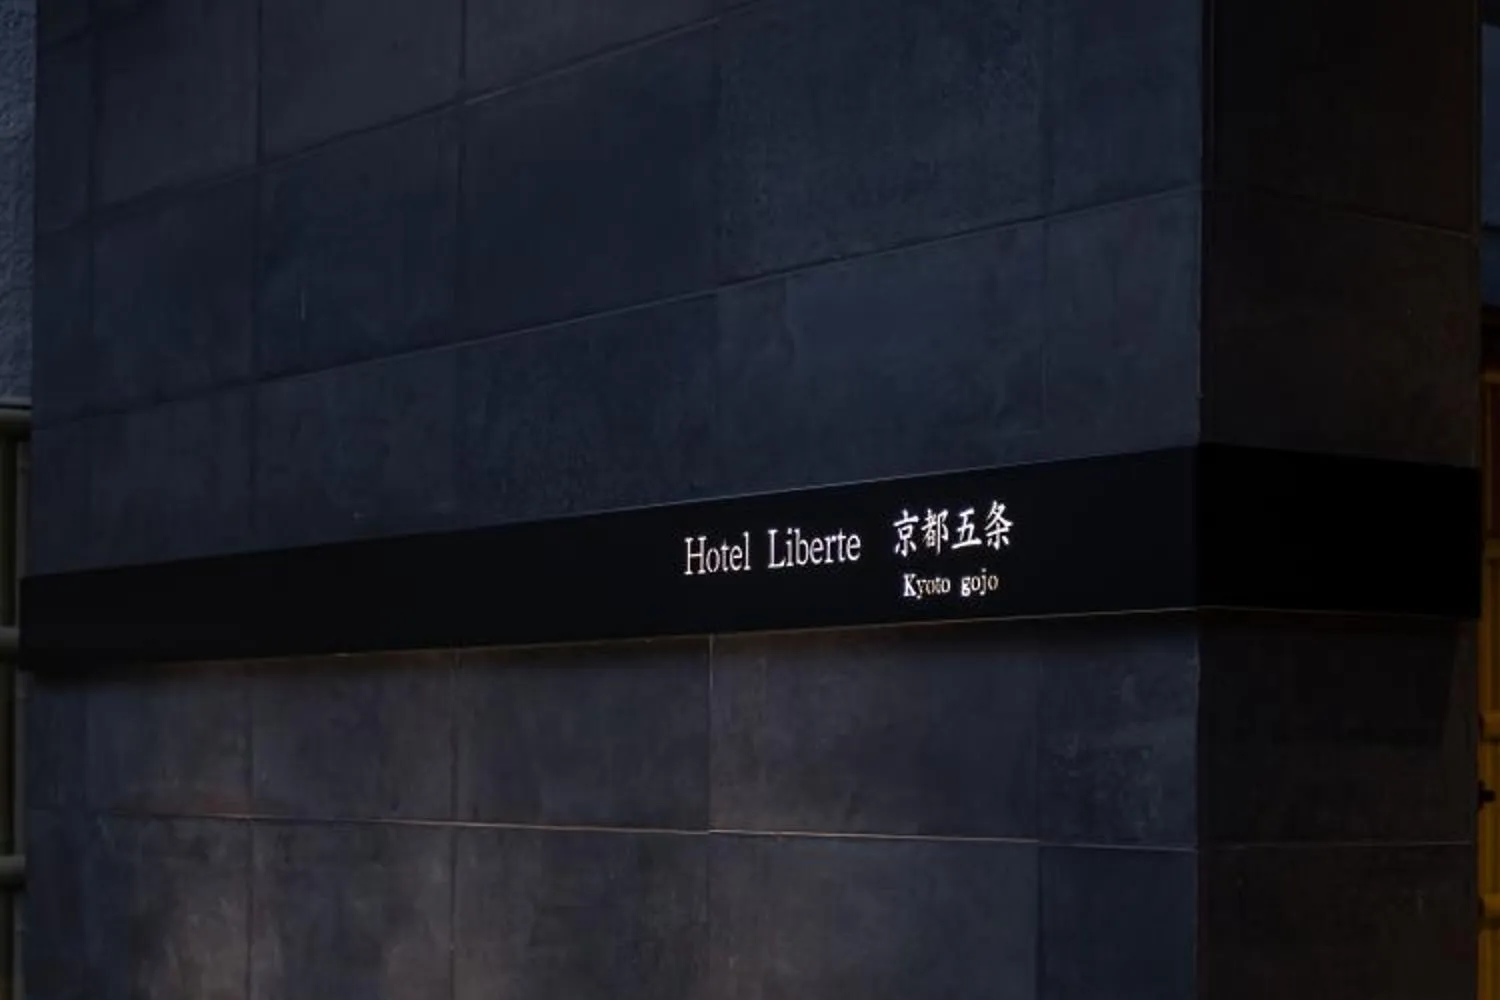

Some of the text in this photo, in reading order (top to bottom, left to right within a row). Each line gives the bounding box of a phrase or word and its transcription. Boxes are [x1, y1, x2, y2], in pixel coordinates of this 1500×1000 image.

[683, 499, 1014, 576] Hotel Liberte 京都五条
[902, 568, 1000, 600] Kyoto gojo
